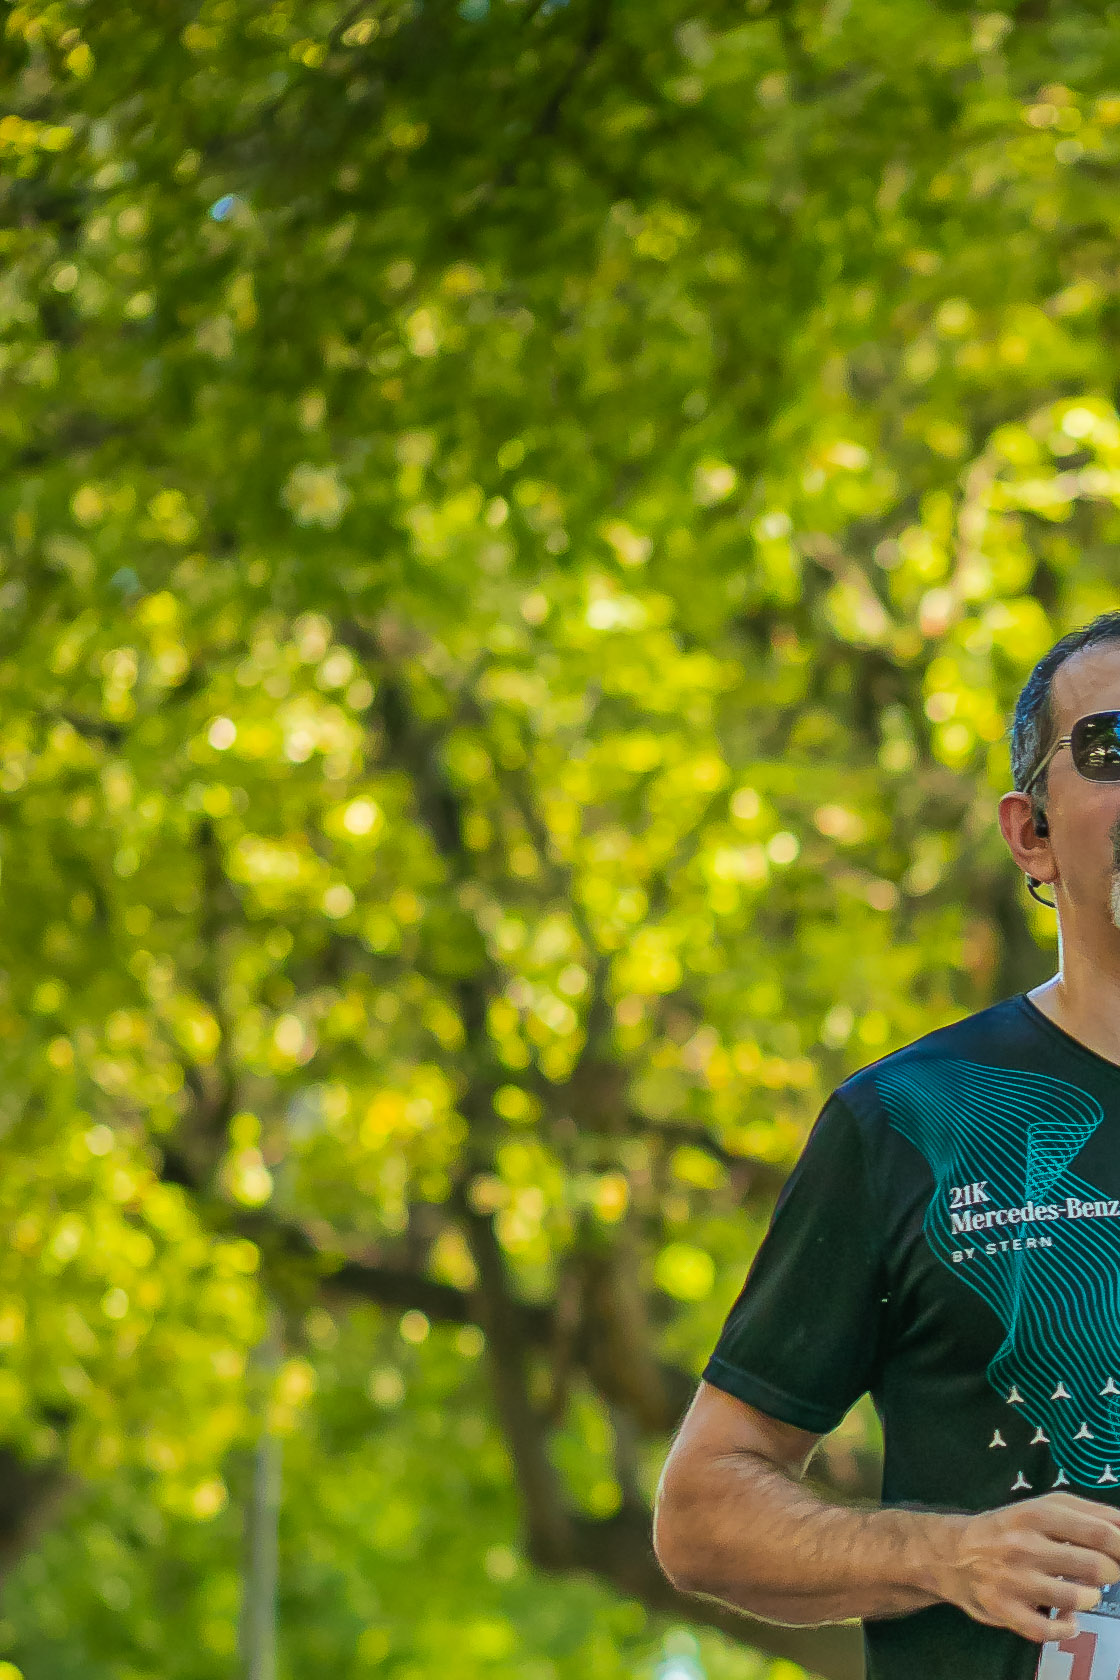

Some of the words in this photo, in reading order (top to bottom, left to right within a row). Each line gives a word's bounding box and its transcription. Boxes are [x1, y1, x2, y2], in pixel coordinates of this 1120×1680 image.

[949, 1181, 990, 1209] 21K
[950, 1248, 976, 1264] BY
[985, 1236, 1053, 1255] STERN
